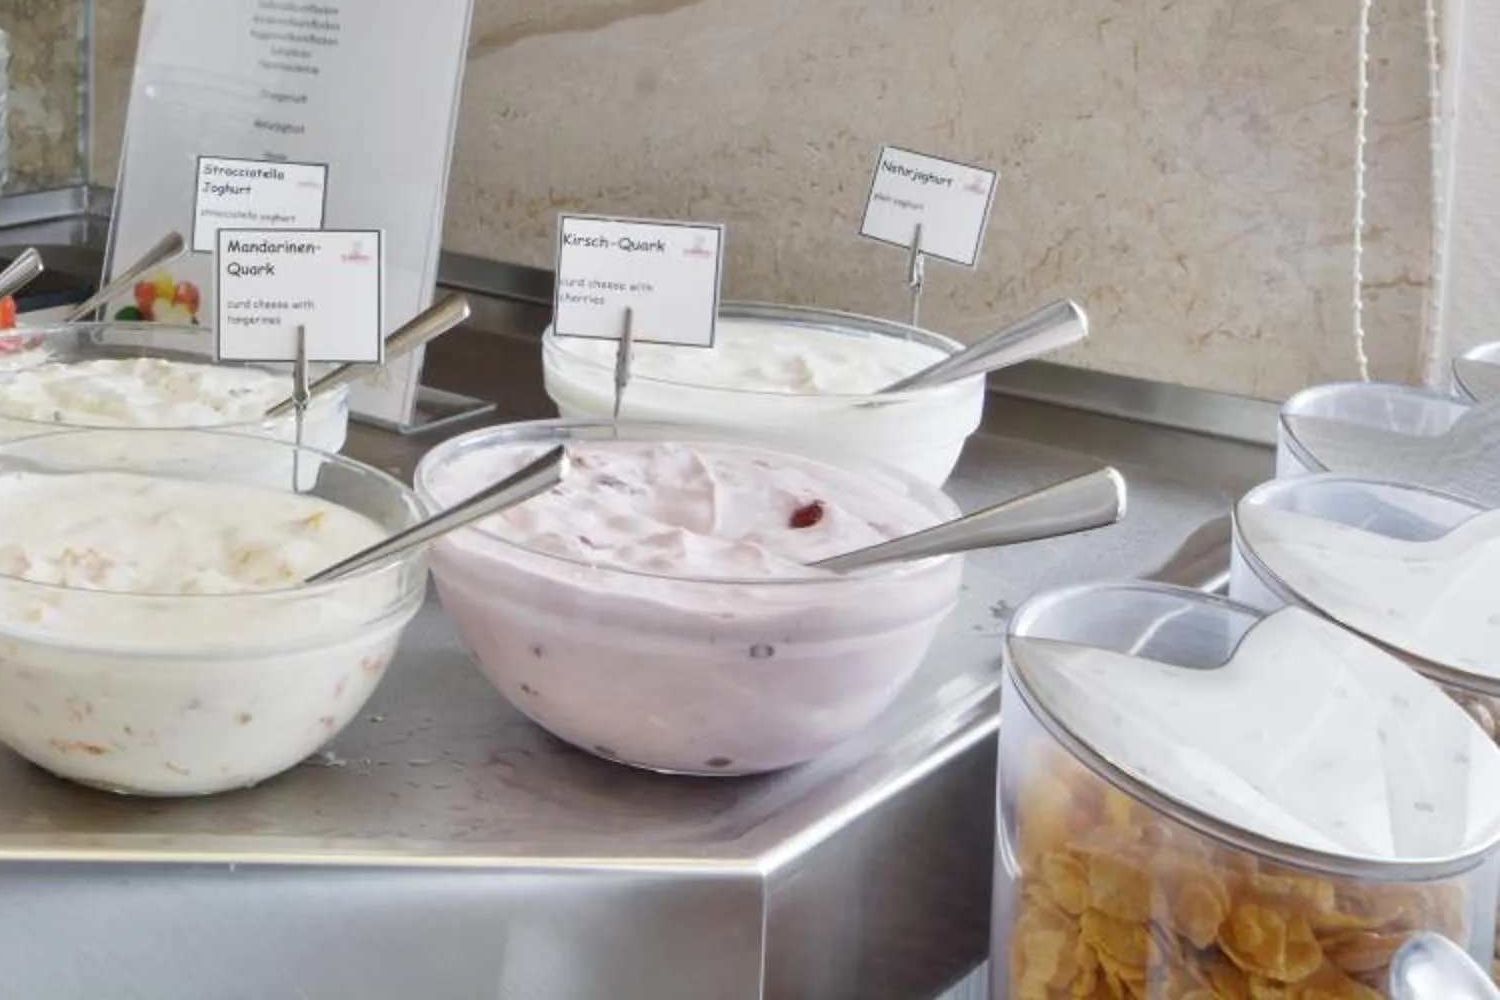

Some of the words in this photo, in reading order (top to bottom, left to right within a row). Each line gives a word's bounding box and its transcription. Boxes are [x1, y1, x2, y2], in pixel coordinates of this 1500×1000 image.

[203, 164, 285, 181] Stracciatella
[201, 181, 252, 197] Joghurt
[563, 232, 667, 253] Kirsch-Quark
[227, 261, 275, 277] Quark
